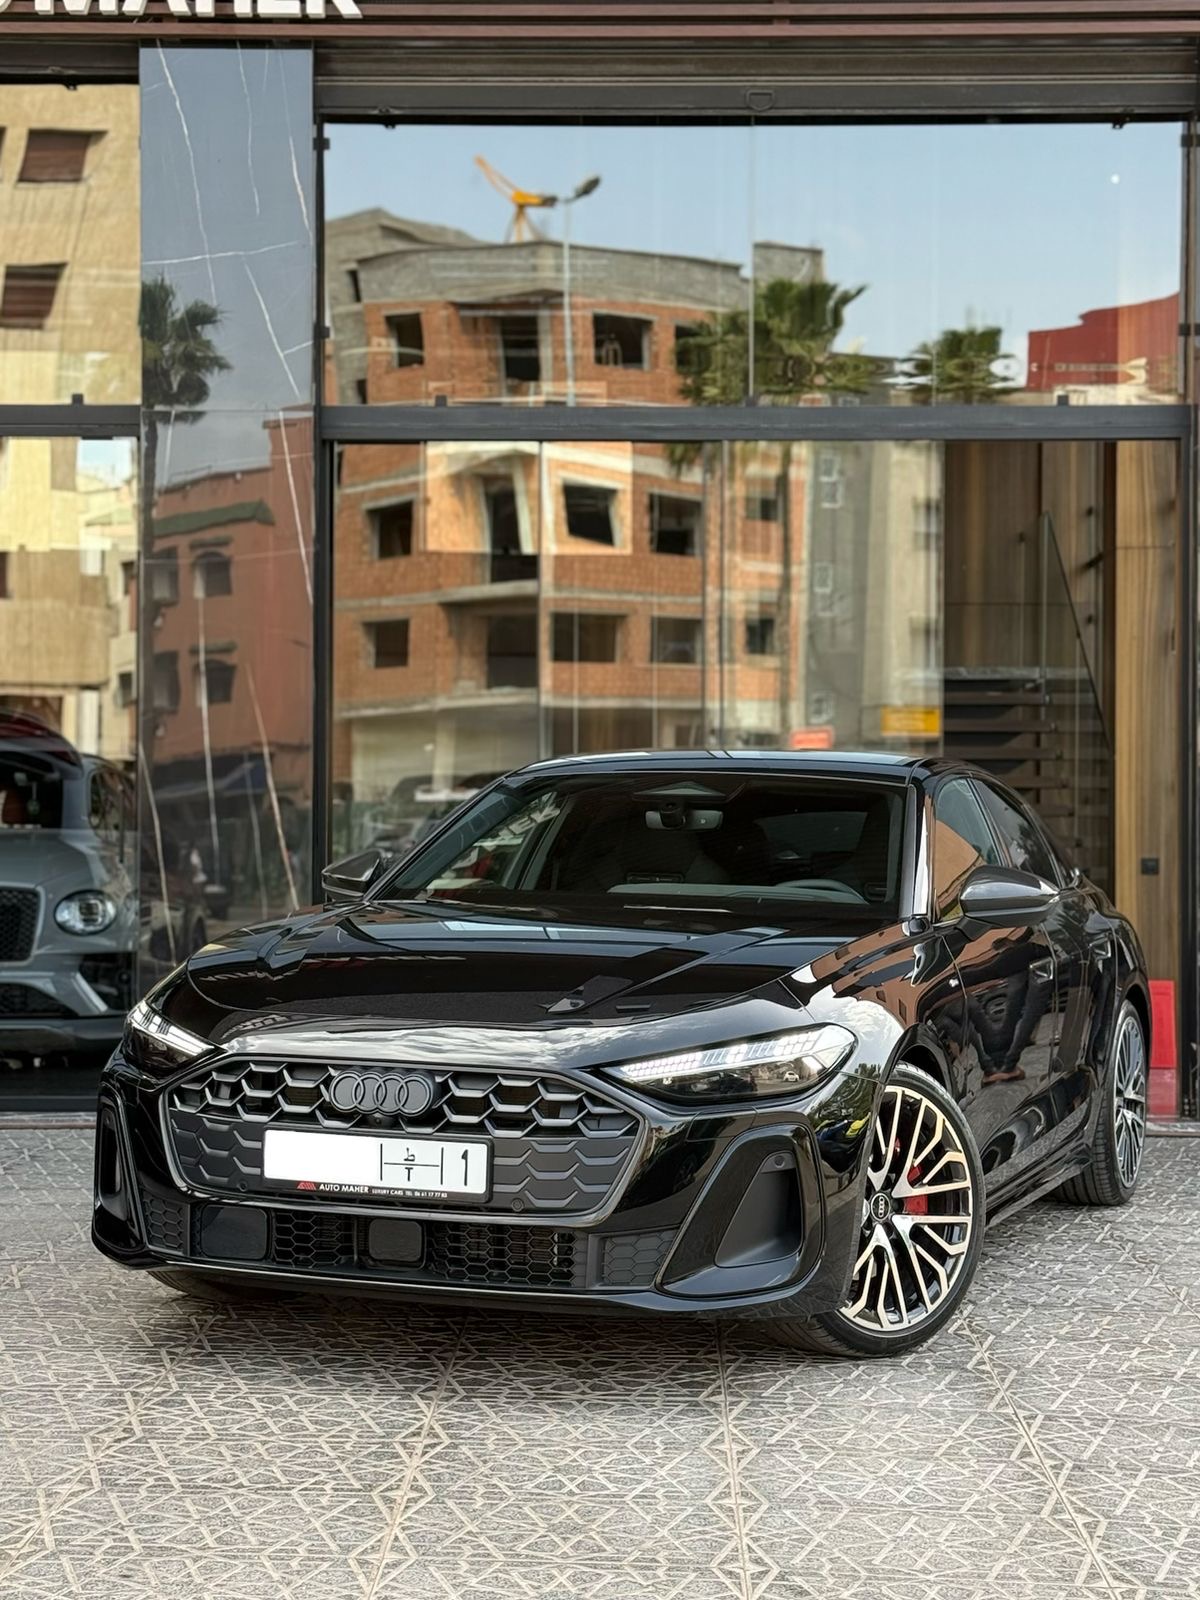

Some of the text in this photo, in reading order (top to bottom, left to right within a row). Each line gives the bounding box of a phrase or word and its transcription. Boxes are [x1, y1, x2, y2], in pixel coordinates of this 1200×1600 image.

[404, 1147, 415, 1162] ط
[405, 1167, 414, 1181] T
[461, 1149, 468, 1187] 1
[319, 1183, 340, 1192] AUTO
[341, 1185, 369, 1193] MAHER
